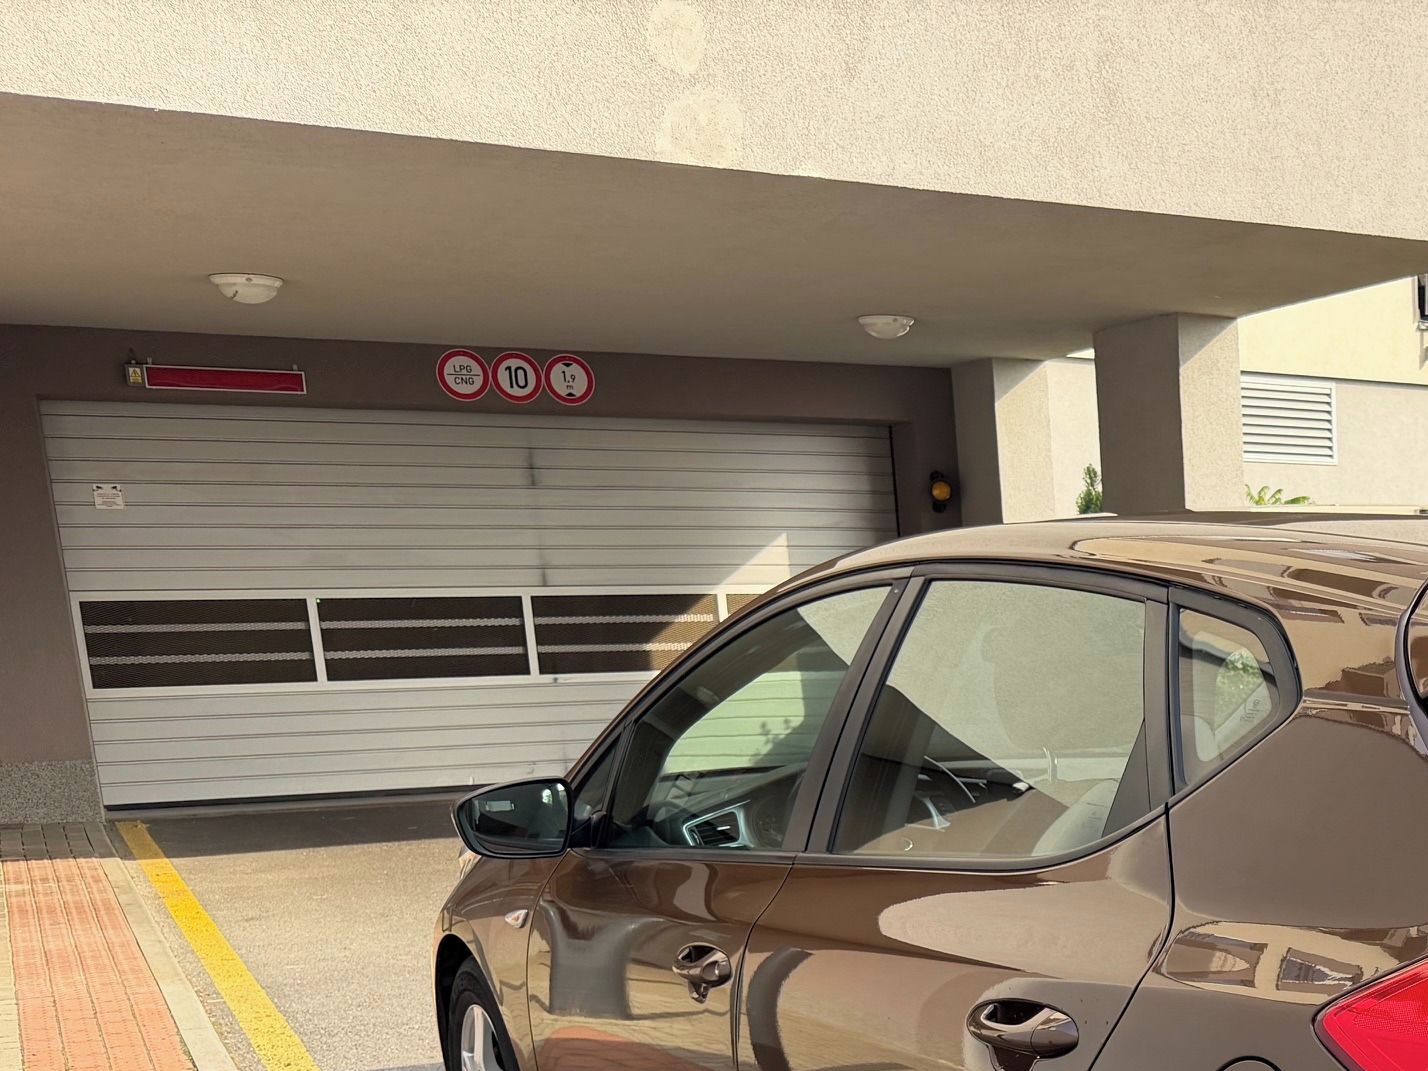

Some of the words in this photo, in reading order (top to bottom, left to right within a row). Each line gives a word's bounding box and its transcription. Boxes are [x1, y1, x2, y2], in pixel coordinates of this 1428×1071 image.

[453, 364, 472, 373] LPG
[454, 377, 475, 386] CNG
[505, 366, 528, 389] 10
